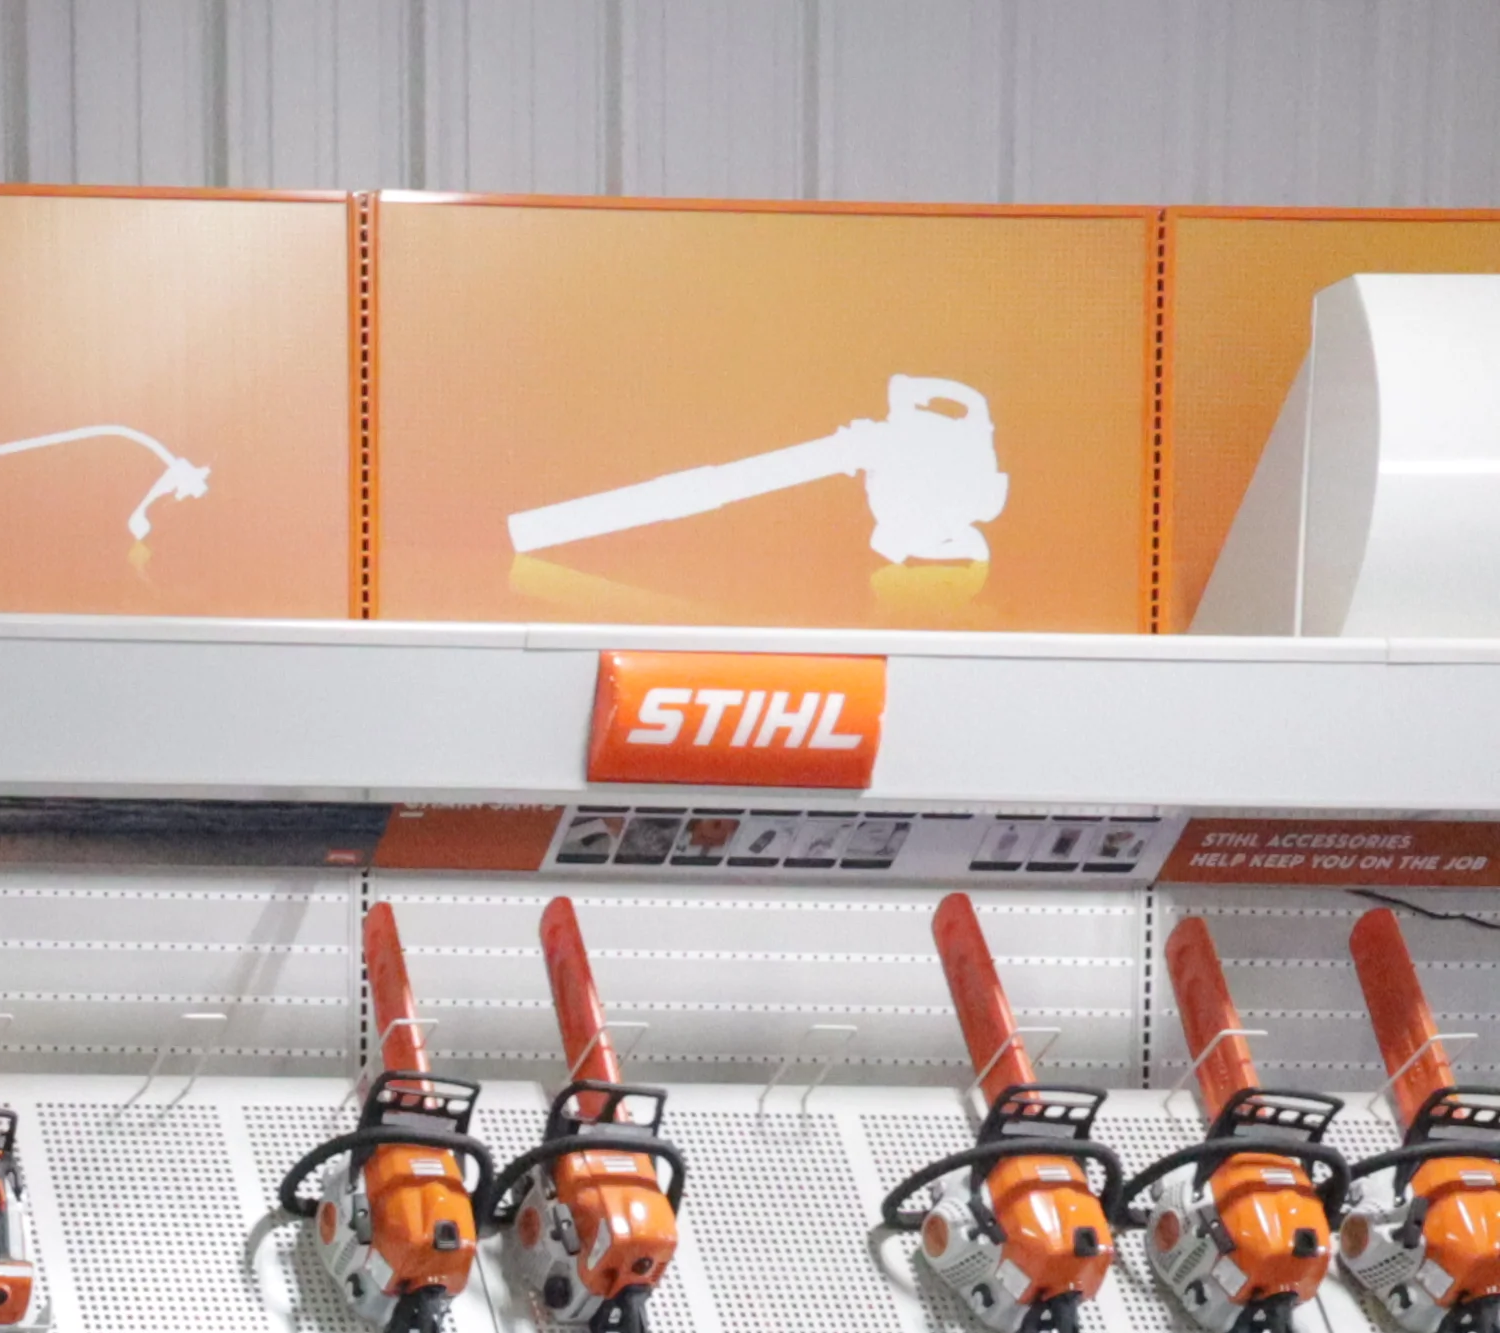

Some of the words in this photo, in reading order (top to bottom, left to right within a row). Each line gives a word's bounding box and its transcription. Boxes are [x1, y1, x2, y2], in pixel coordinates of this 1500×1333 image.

[626, 687, 863, 749] STIHL
[1201, 832, 1259, 848] STIHL
[1266, 833, 1413, 849] ACCESSORIES
[1189, 853, 1246, 867] HELP
[1248, 854, 1306, 868] KEEP
[1311, 854, 1356, 868] YOU
[1359, 855, 1393, 869] ON
[1398, 856, 1438, 870] THE
[1442, 856, 1488, 871] JOB
